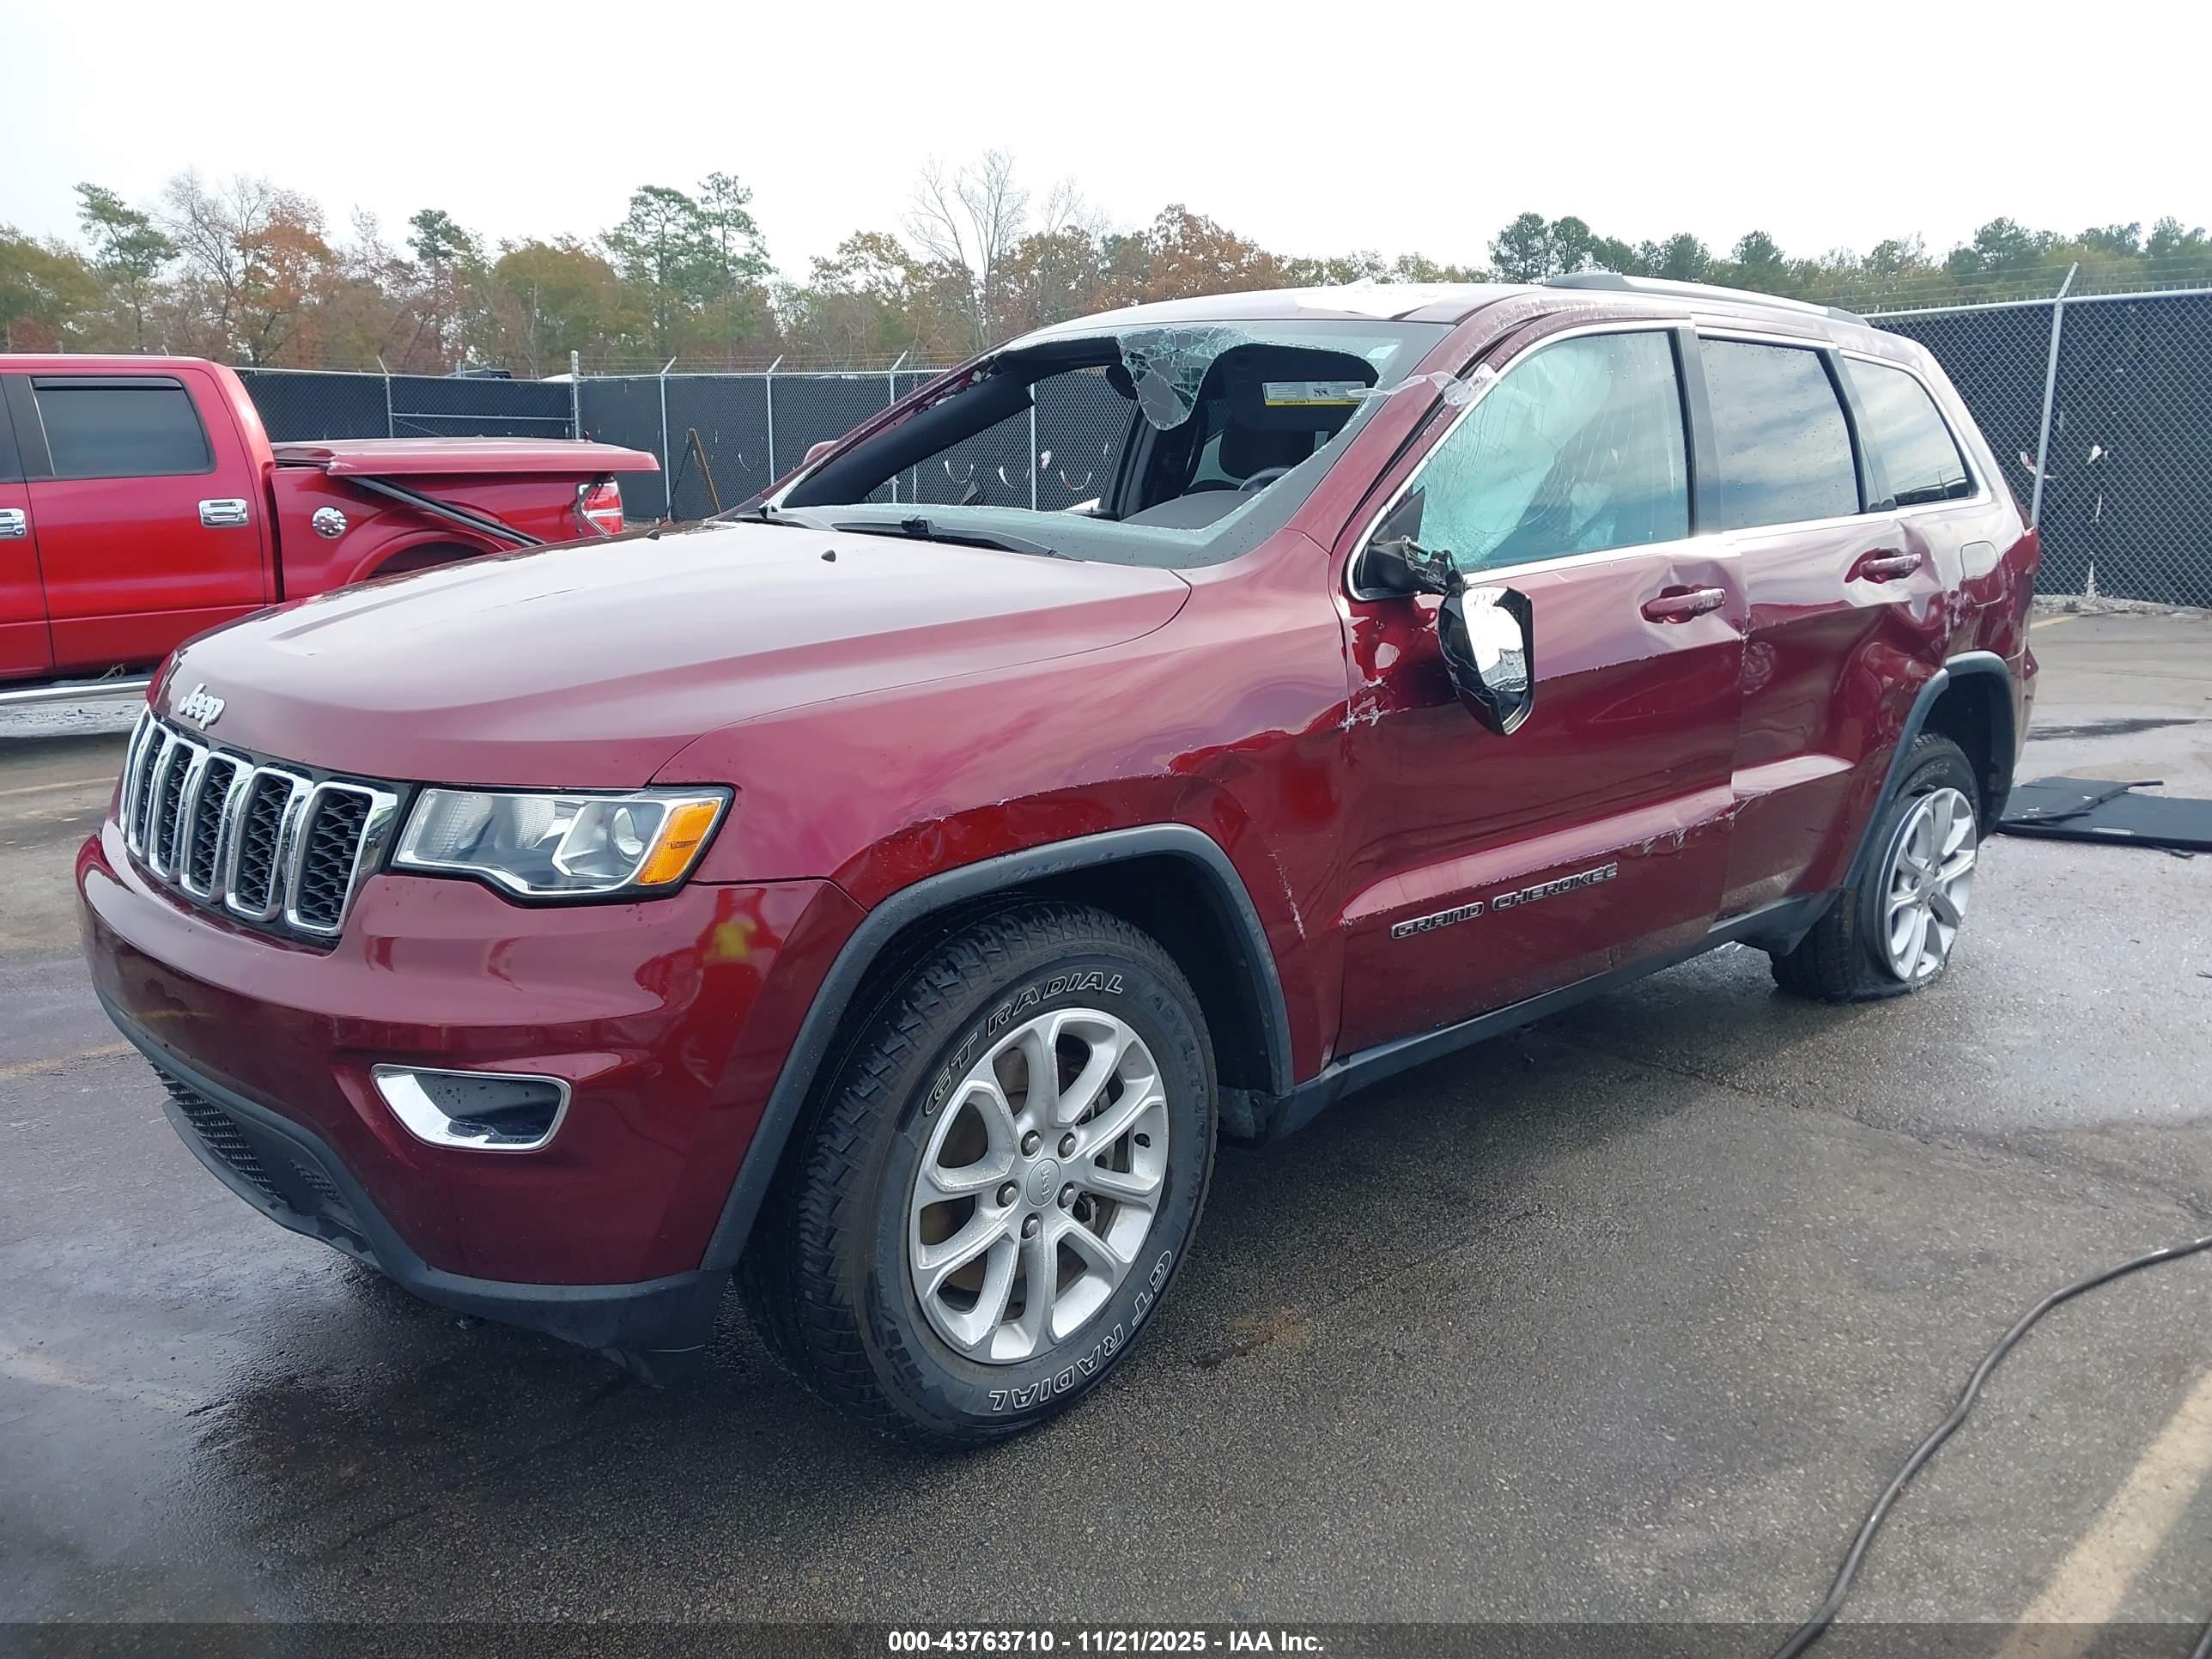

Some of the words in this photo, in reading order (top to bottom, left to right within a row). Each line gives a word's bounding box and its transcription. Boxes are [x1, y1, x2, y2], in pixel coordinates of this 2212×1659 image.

[178, 683, 225, 731] Jeep
[1390, 902, 1484, 940] GRAND
[1492, 860, 1619, 911] CHEROKEE
[925, 1031, 978, 1115] GT
[988, 971, 1124, 1036] RADIAL
[1040, 1166, 1052, 1202] Jeep
[1132, 1250, 1173, 1327] GT
[989, 1323, 1125, 1411] RADIAL
